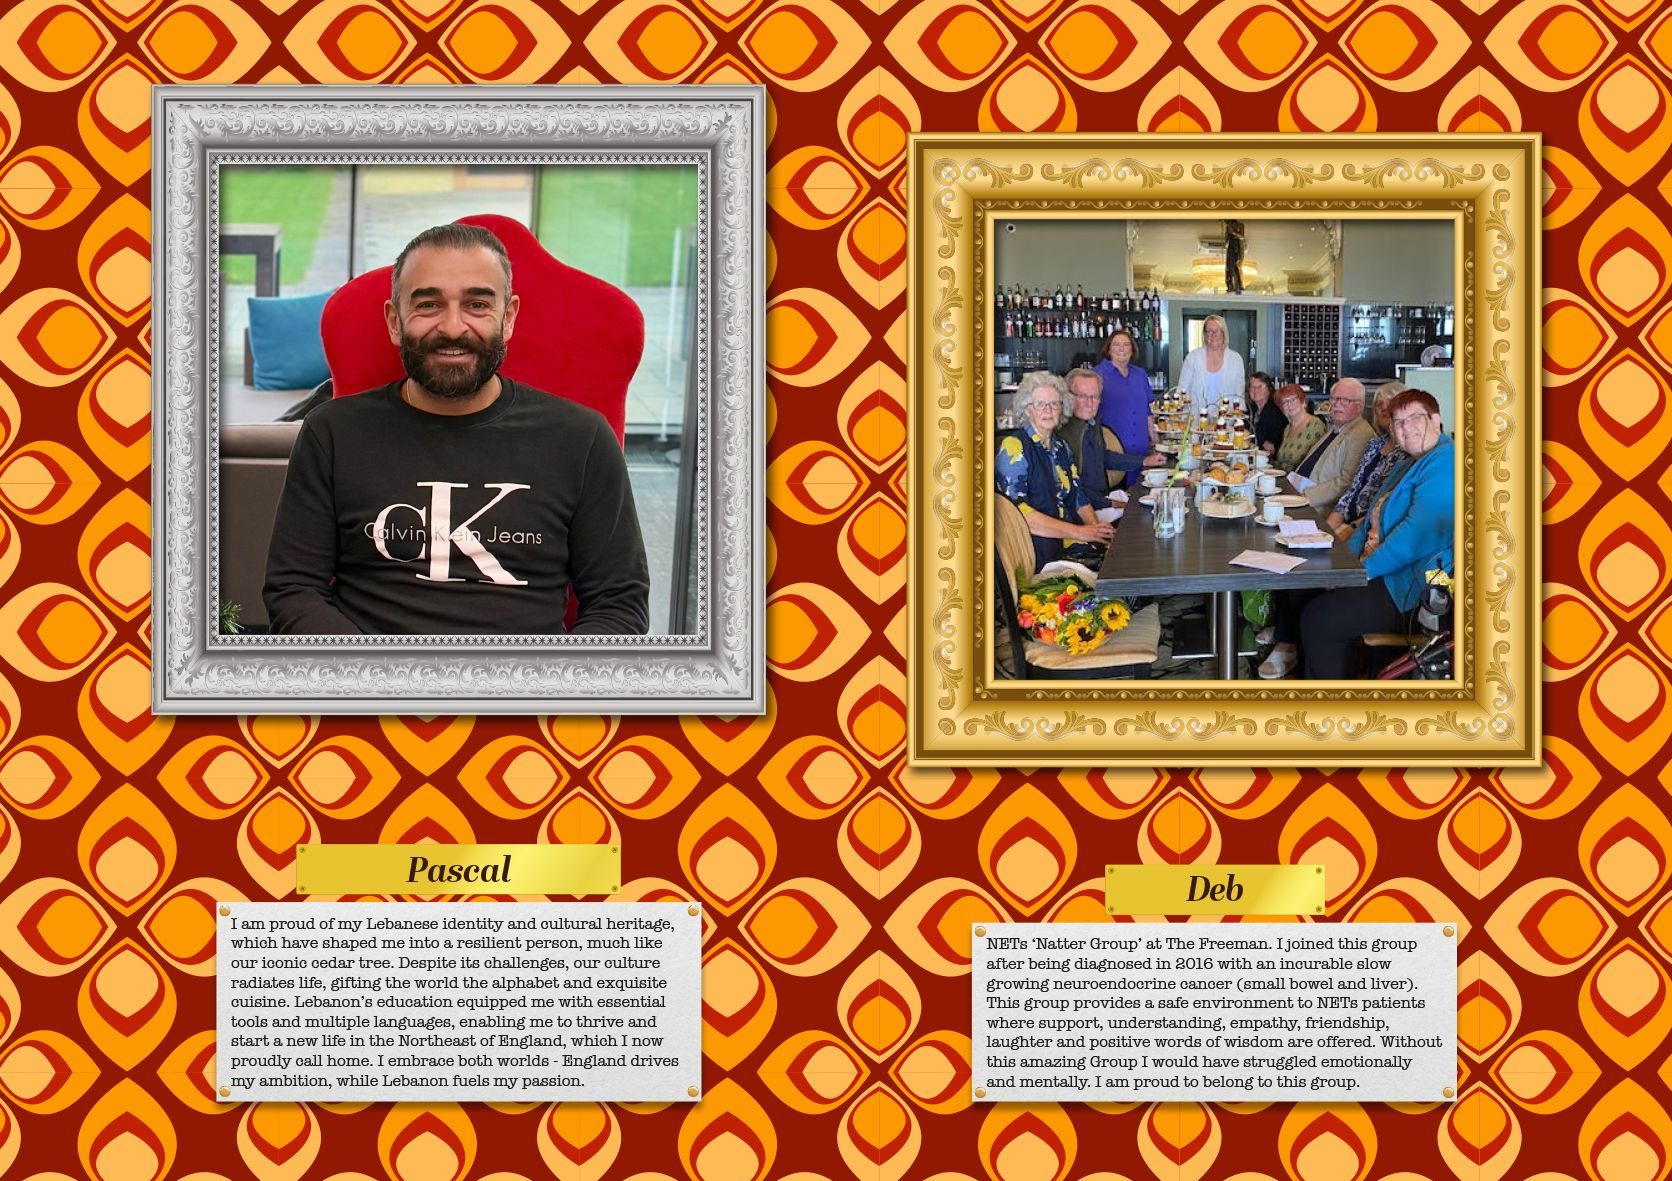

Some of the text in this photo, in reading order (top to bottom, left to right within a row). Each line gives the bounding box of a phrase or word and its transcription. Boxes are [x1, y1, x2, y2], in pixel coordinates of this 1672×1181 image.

[363, 522, 542, 545] Calvin Kein Jeans
[406, 854, 512, 883] Pascal
[1185, 874, 1244, 902] Deb
[230, 917, 675, 933] I am proud of my Lebanese identity and cultural heritage,
[230, 936, 663, 952] which have shaped me into a resilient person, much like
[986, 937, 1028, 950] NETs
[1145, 937, 1163, 950] at
[1165, 937, 1195, 950] The
[1198, 937, 1272, 950] Freeman.
[1276, 937, 1284, 950] I
[1284, 937, 1335, 953] joined
[1337, 937, 1368, 950] this
[1371, 938, 1418, 953] group
[230, 956, 661, 972] our iconic cedar tree. Despite its challenges, our culture
[986, 957, 1393, 973] after being diagnosed in 2016 with an incurable slow
[230, 976, 668, 992] radiates life, gifting the world the alphabet and exquisite
[986, 977, 1418, 993] growing neuroendocrine cancer (small bowel and liver).
[230, 995, 290, 1008] cuisine.
[376, 995, 454, 1008] education
[456, 995, 528, 1011] equipped
[530, 998, 555, 1008] me
[557, 995, 594, 1008] with
[596, 995, 667, 1008] essential
[986, 996, 1426, 1012] This group provides a safe environment to NETs patients
[230, 1015, 658, 1031] tools and multiple languages, enabling me to thrive and
[985, 1016, 1390, 1032] where support, understanding, empathy, friendship,
[231, 1034, 665, 1050] start a new life in the Northeast of England, which I now
[985, 1035, 1443, 1051] laughter and positive words of wisdom are offered. Without
[230, 1054, 293, 1070] proudly
[295, 1054, 324, 1067] call
[326, 1054, 374, 1067] home.
[377, 1054, 385, 1067] I
[387, 1054, 455, 1067] embrace
[457, 1054, 494, 1067] both
[496, 1054, 550, 1067] worlds
[561, 1054, 628, 1070] England
[630, 1054, 680, 1067] drives
[986, 1055, 1414, 1071] this amazing Group I would have struggled emotionally
[230, 1074, 585, 1090] my ambition, while Lebanon fuels my passion.
[986, 1075, 1360, 1091] and mentally. I am proud to belong to this group.
